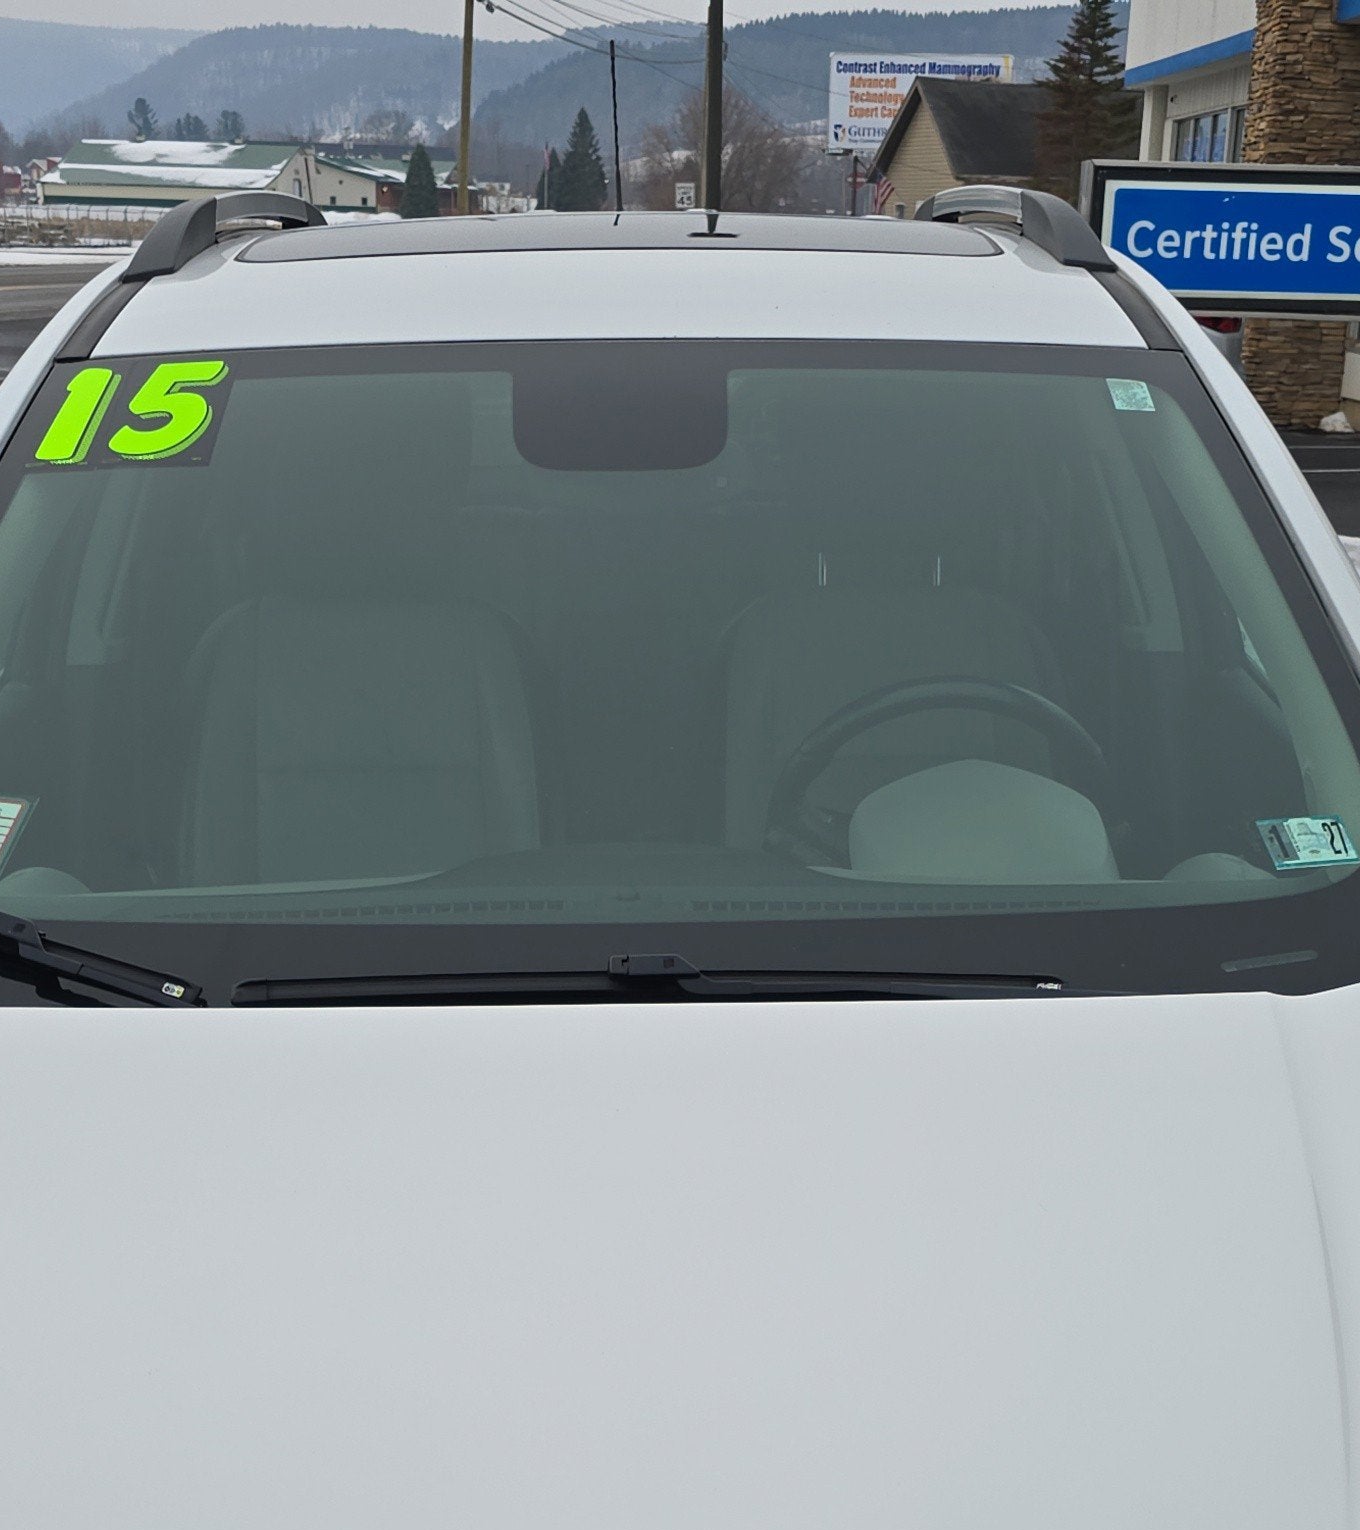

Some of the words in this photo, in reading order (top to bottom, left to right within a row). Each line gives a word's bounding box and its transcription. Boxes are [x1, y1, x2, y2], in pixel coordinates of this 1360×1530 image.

[836, 60, 877, 74] Contrast
[879, 61, 926, 75] Enhanced
[928, 62, 1001, 77] Mammography
[849, 76, 897, 89] Advanced
[848, 105, 879, 118] Expert
[881, 105, 898, 118] Car
[1126, 219, 1313, 262] Certified
[35, 360, 229, 463] 15
[1321, 821, 1349, 857] 27
